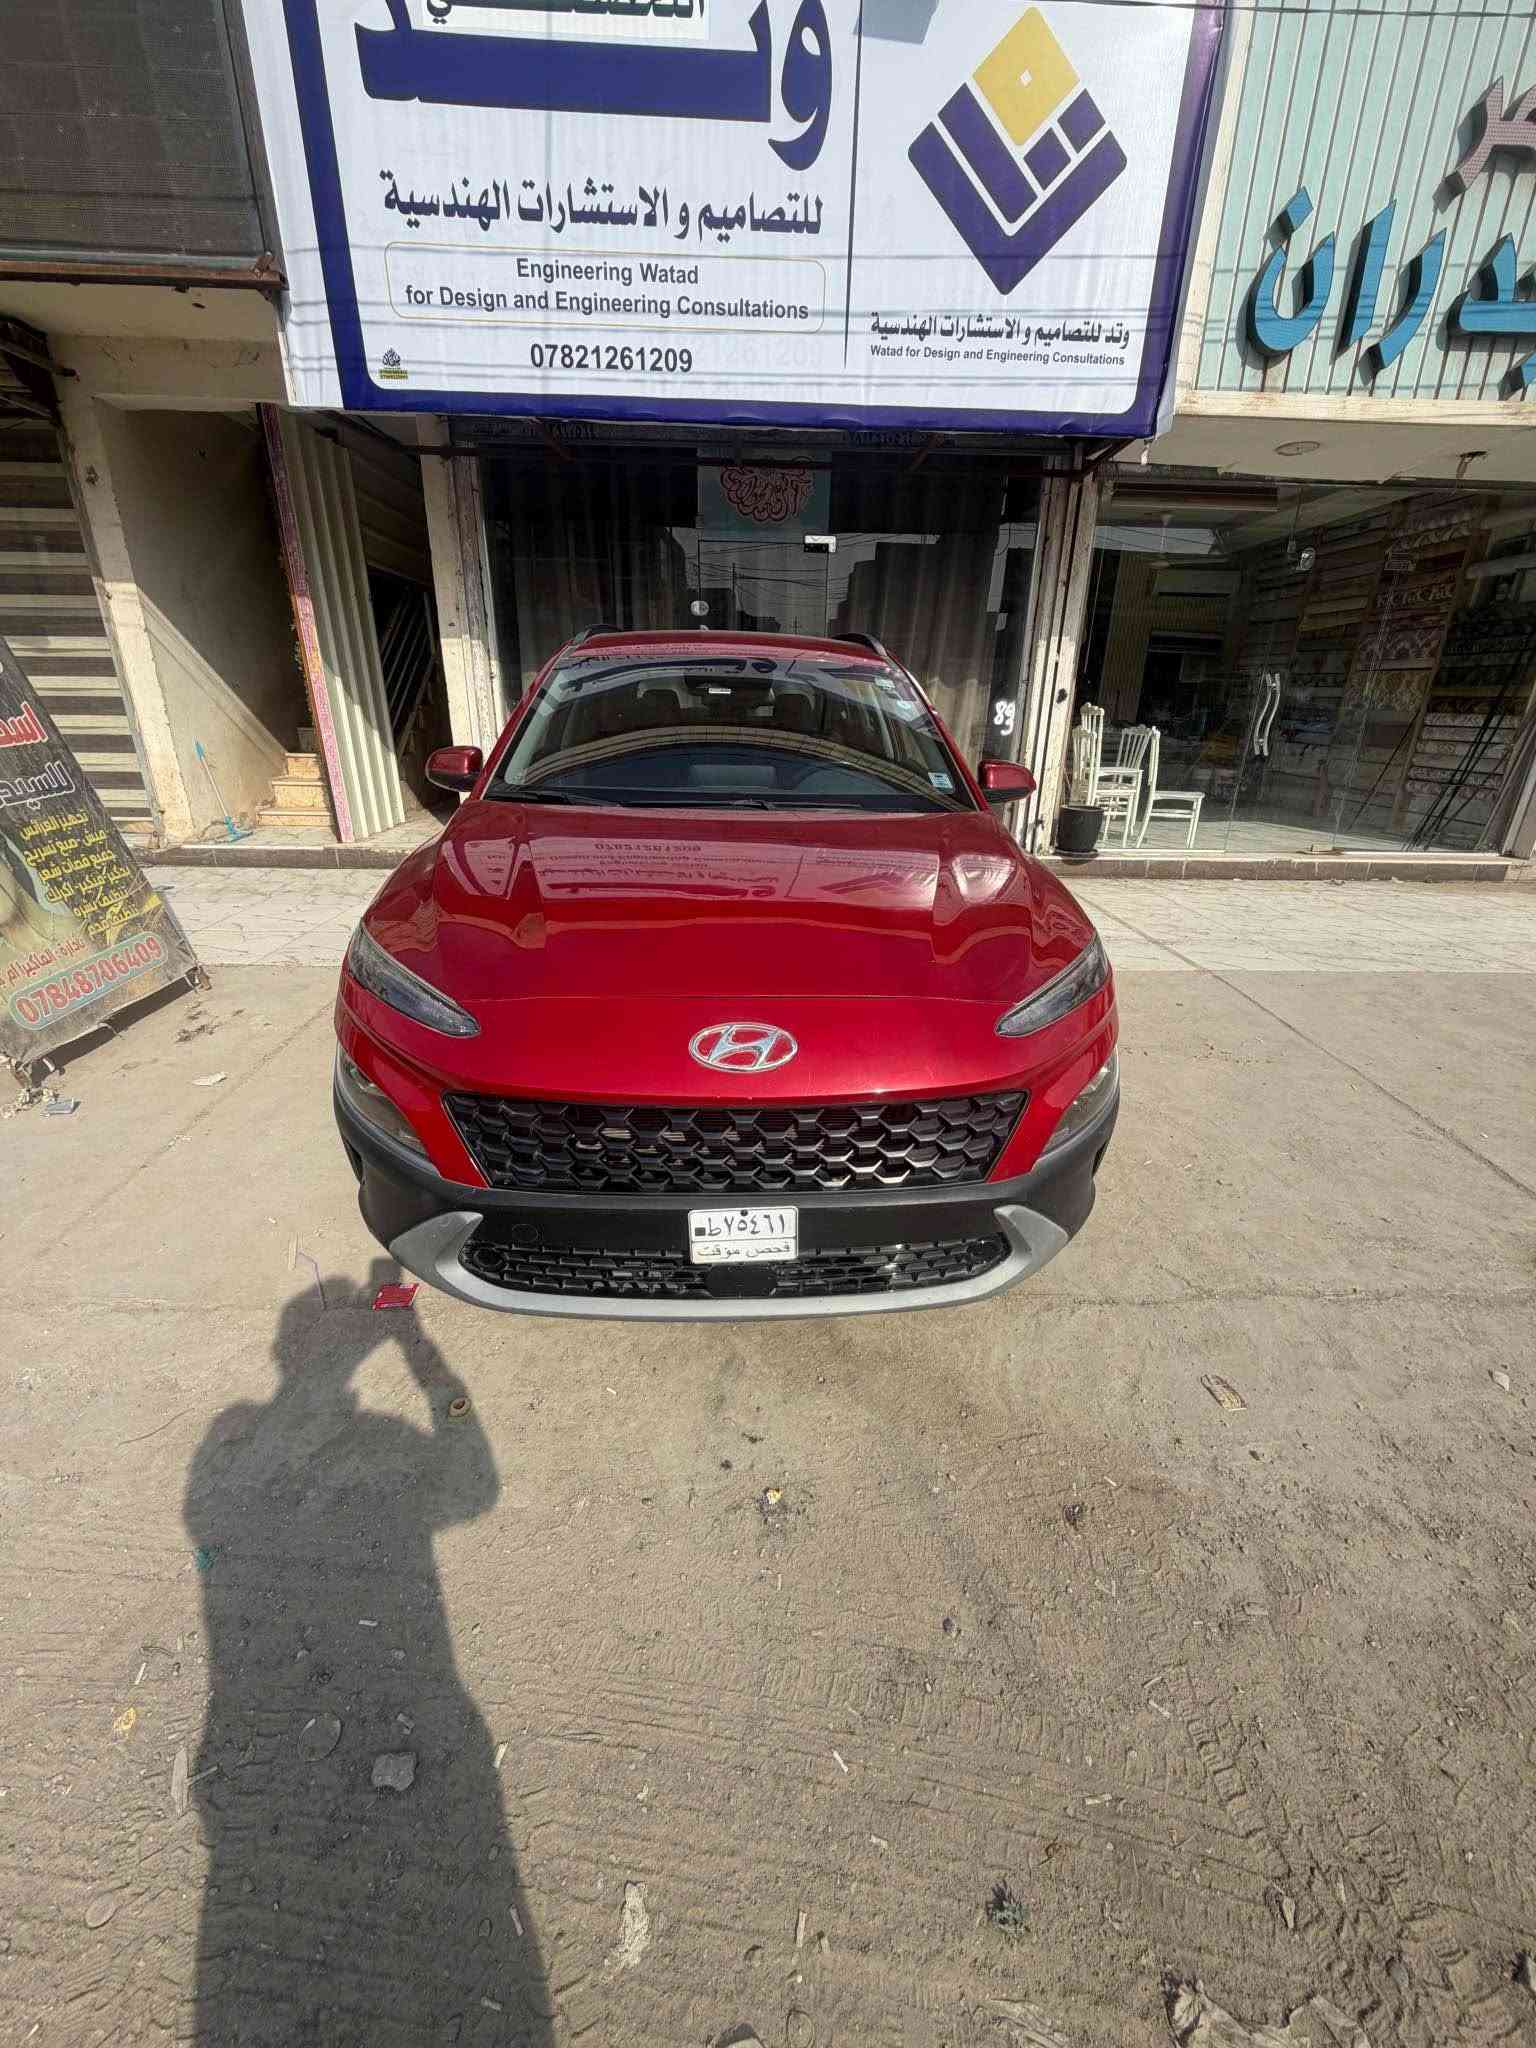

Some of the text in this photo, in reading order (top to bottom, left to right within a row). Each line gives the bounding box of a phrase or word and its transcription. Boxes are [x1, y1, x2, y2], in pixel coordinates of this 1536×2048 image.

[379, 169, 511, 232] الهندسية
[698, 191, 823, 247] للتصاميم
[516, 257, 699, 286] Engineering Watad
[406, 285, 809, 319] for Design and Engineering Consultations
[871, 311, 937, 342] الهندسية
[1035, 320, 1102, 347] للتصاميم
[1104, 322, 1130, 349] وتد
[530, 343, 692, 372] 07821261209
[871, 345, 1125, 365] Watad for Design and Engineering Consultations
